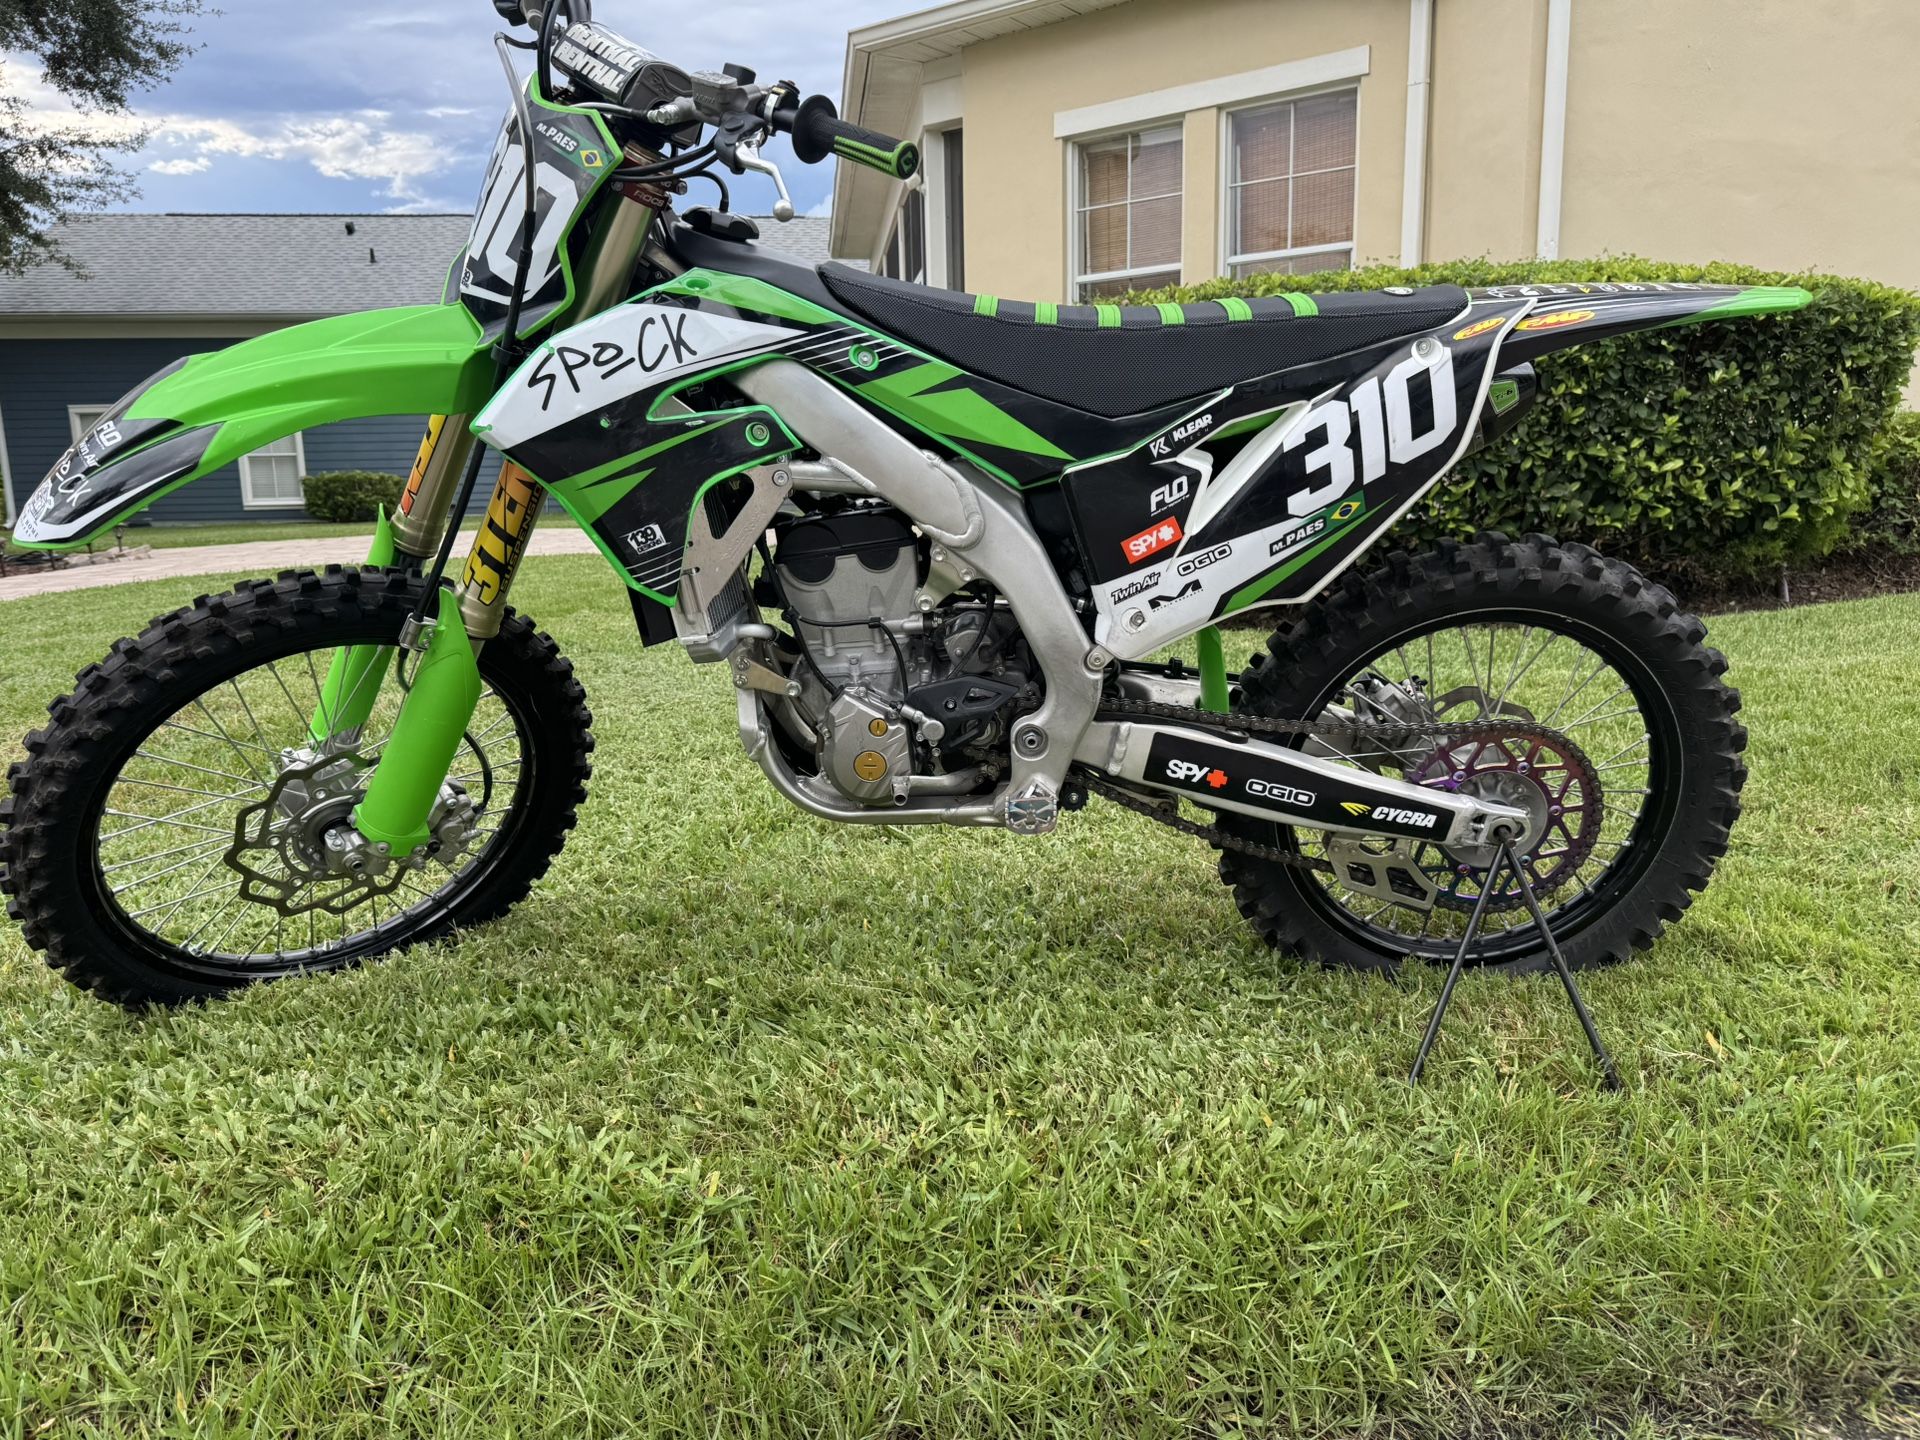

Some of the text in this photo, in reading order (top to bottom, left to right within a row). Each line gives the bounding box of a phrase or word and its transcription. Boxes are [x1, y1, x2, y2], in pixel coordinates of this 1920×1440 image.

[565, 23, 643, 73] RENTHAL
[553, 40, 625, 94] RENTHAL
[1172, 413, 1213, 443] KLEAR
[1283, 346, 1457, 518] 310
[1150, 475, 1188, 513] FLO
[500, 484, 544, 593] SUSPENSIO
[630, 526, 657, 547] 139
[1177, 544, 1232, 577] OGIO
[1246, 779, 1315, 807] OGIO
[1371, 806, 1437, 829] CYCRA
